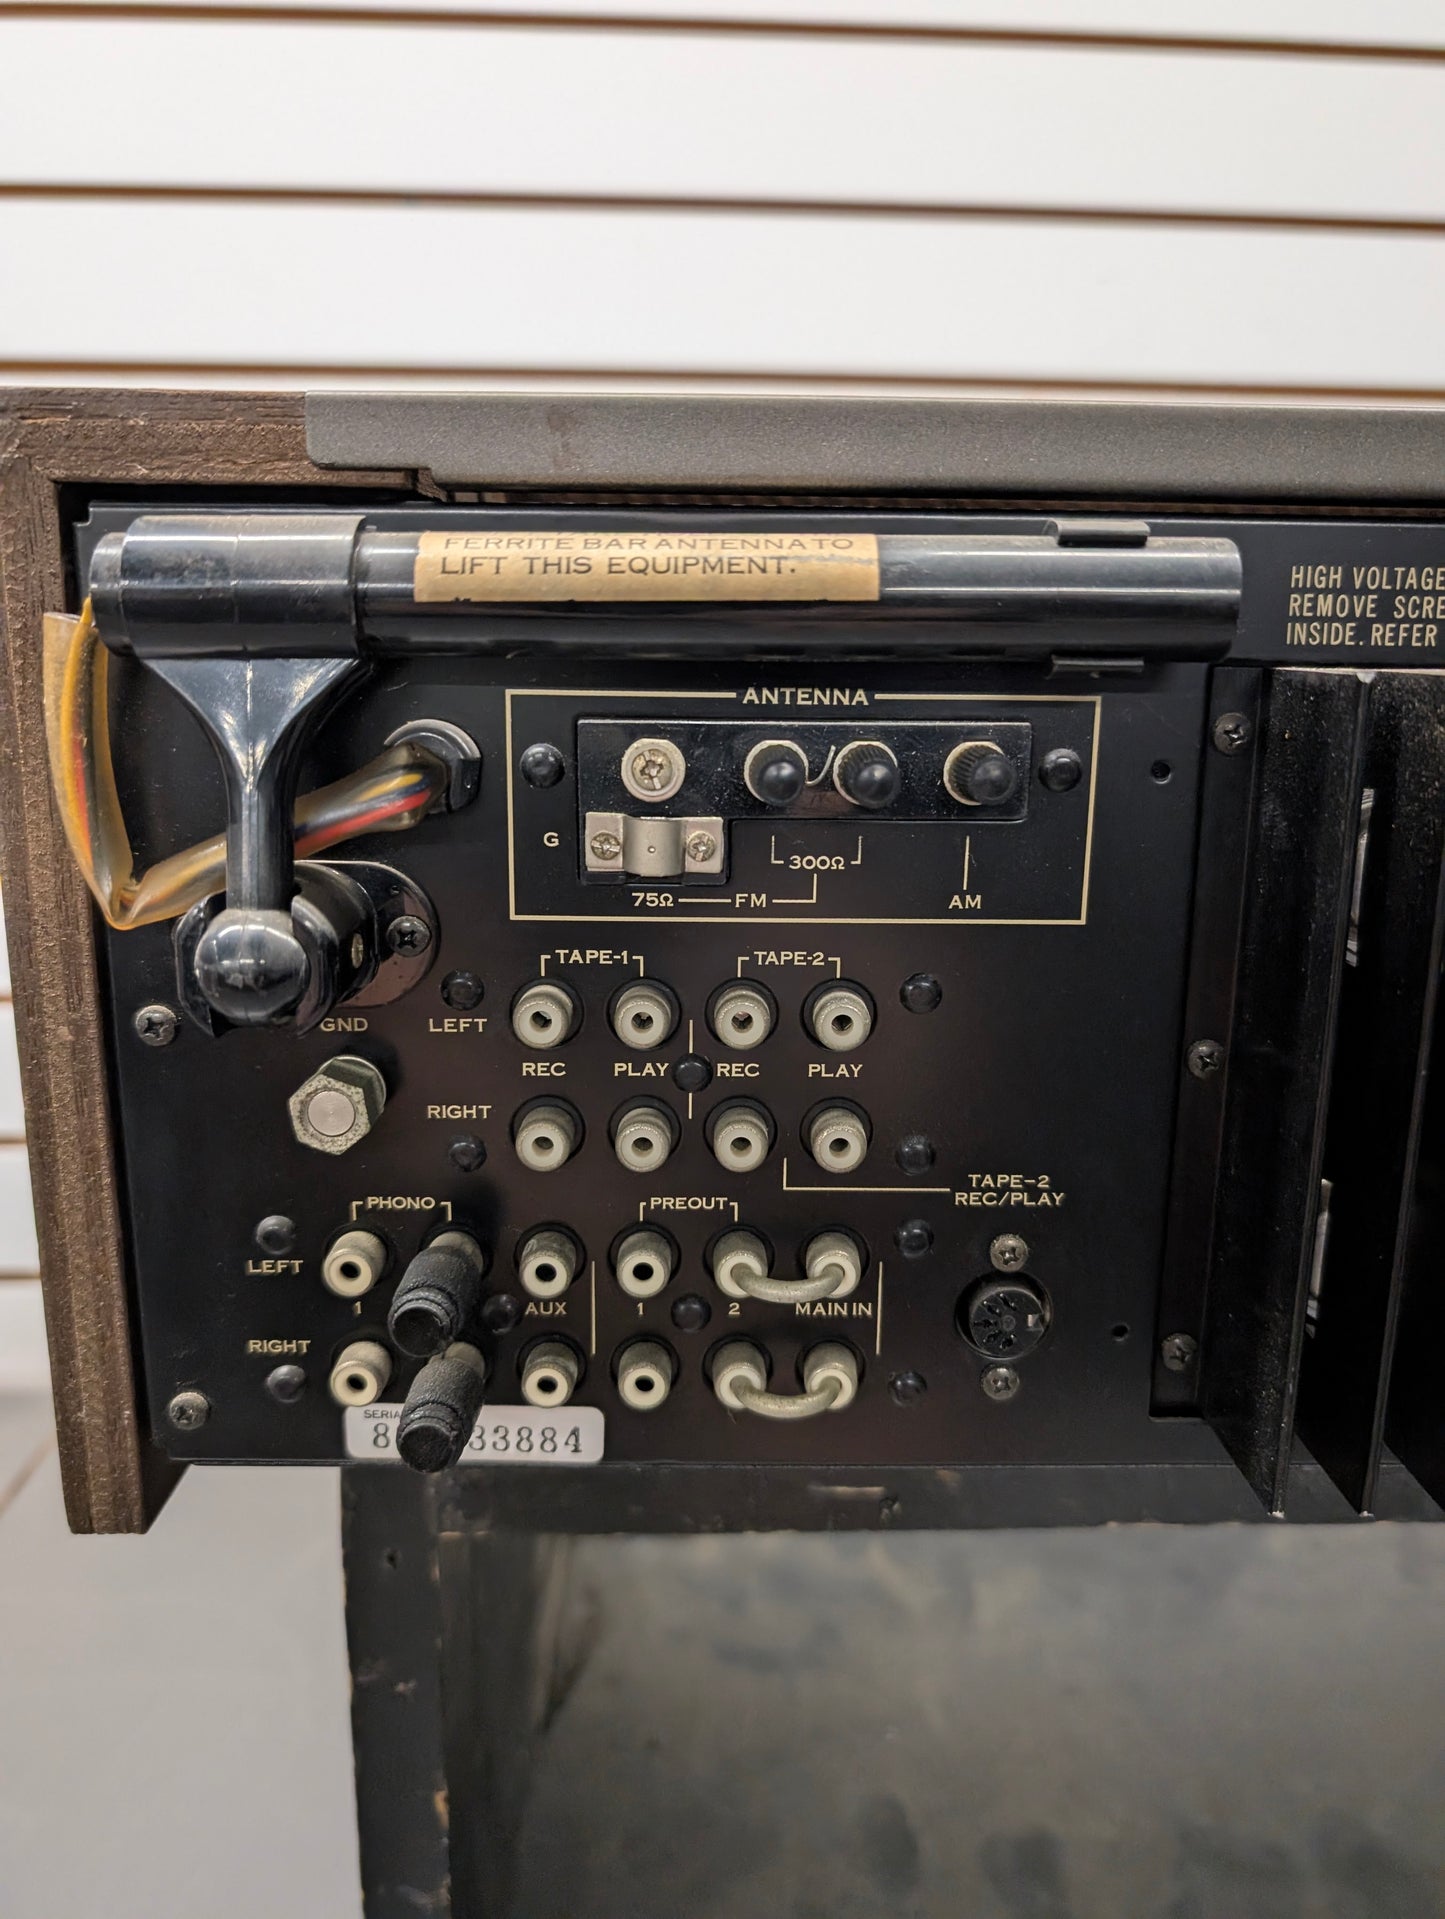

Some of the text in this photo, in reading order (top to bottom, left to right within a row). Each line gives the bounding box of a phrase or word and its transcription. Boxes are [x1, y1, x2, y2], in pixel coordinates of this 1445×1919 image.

[444, 537, 853, 550] FERRITE BAR ANTENNA TO
[440, 556, 796, 576] LIFT THIS EQUIPMENT.
[1290, 565, 1445, 591] HIGH VOLTAGE
[1289, 593, 1378, 618] REMOVE
[1286, 622, 1438, 647] INSIDE. REFER
[742, 687, 869, 706] ANTENNA
[543, 831, 560, 847] G
[735, 893, 767, 908] FM
[948, 894, 982, 910] AM
[554, 949, 629, 965] TAPE-1
[753, 950, 825, 966] TAPE-2
[320, 1017, 369, 1032] GND
[428, 1018, 488, 1033] LEFT
[521, 1062, 566, 1077] REC
[613, 1062, 669, 1077] PLAY
[716, 1063, 760, 1077] REC
[807, 1063, 863, 1078] PLAY
[427, 1104, 492, 1119] RIGHT
[967, 1174, 1050, 1188] TAPE-2
[367, 1196, 436, 1209] PHONO
[650, 1196, 729, 1210] PREOUT
[954, 1191, 1065, 1207] REC/PLAY
[247, 1259, 304, 1274] LEFT
[353, 1301, 362, 1315] 1
[524, 1301, 567, 1316] AUX
[636, 1302, 645, 1316] 1
[728, 1302, 741, 1316] 2
[795, 1302, 873, 1316] MAIN IN
[248, 1339, 311, 1354] RIGHT
[363, 1409, 402, 1419] SERIA
